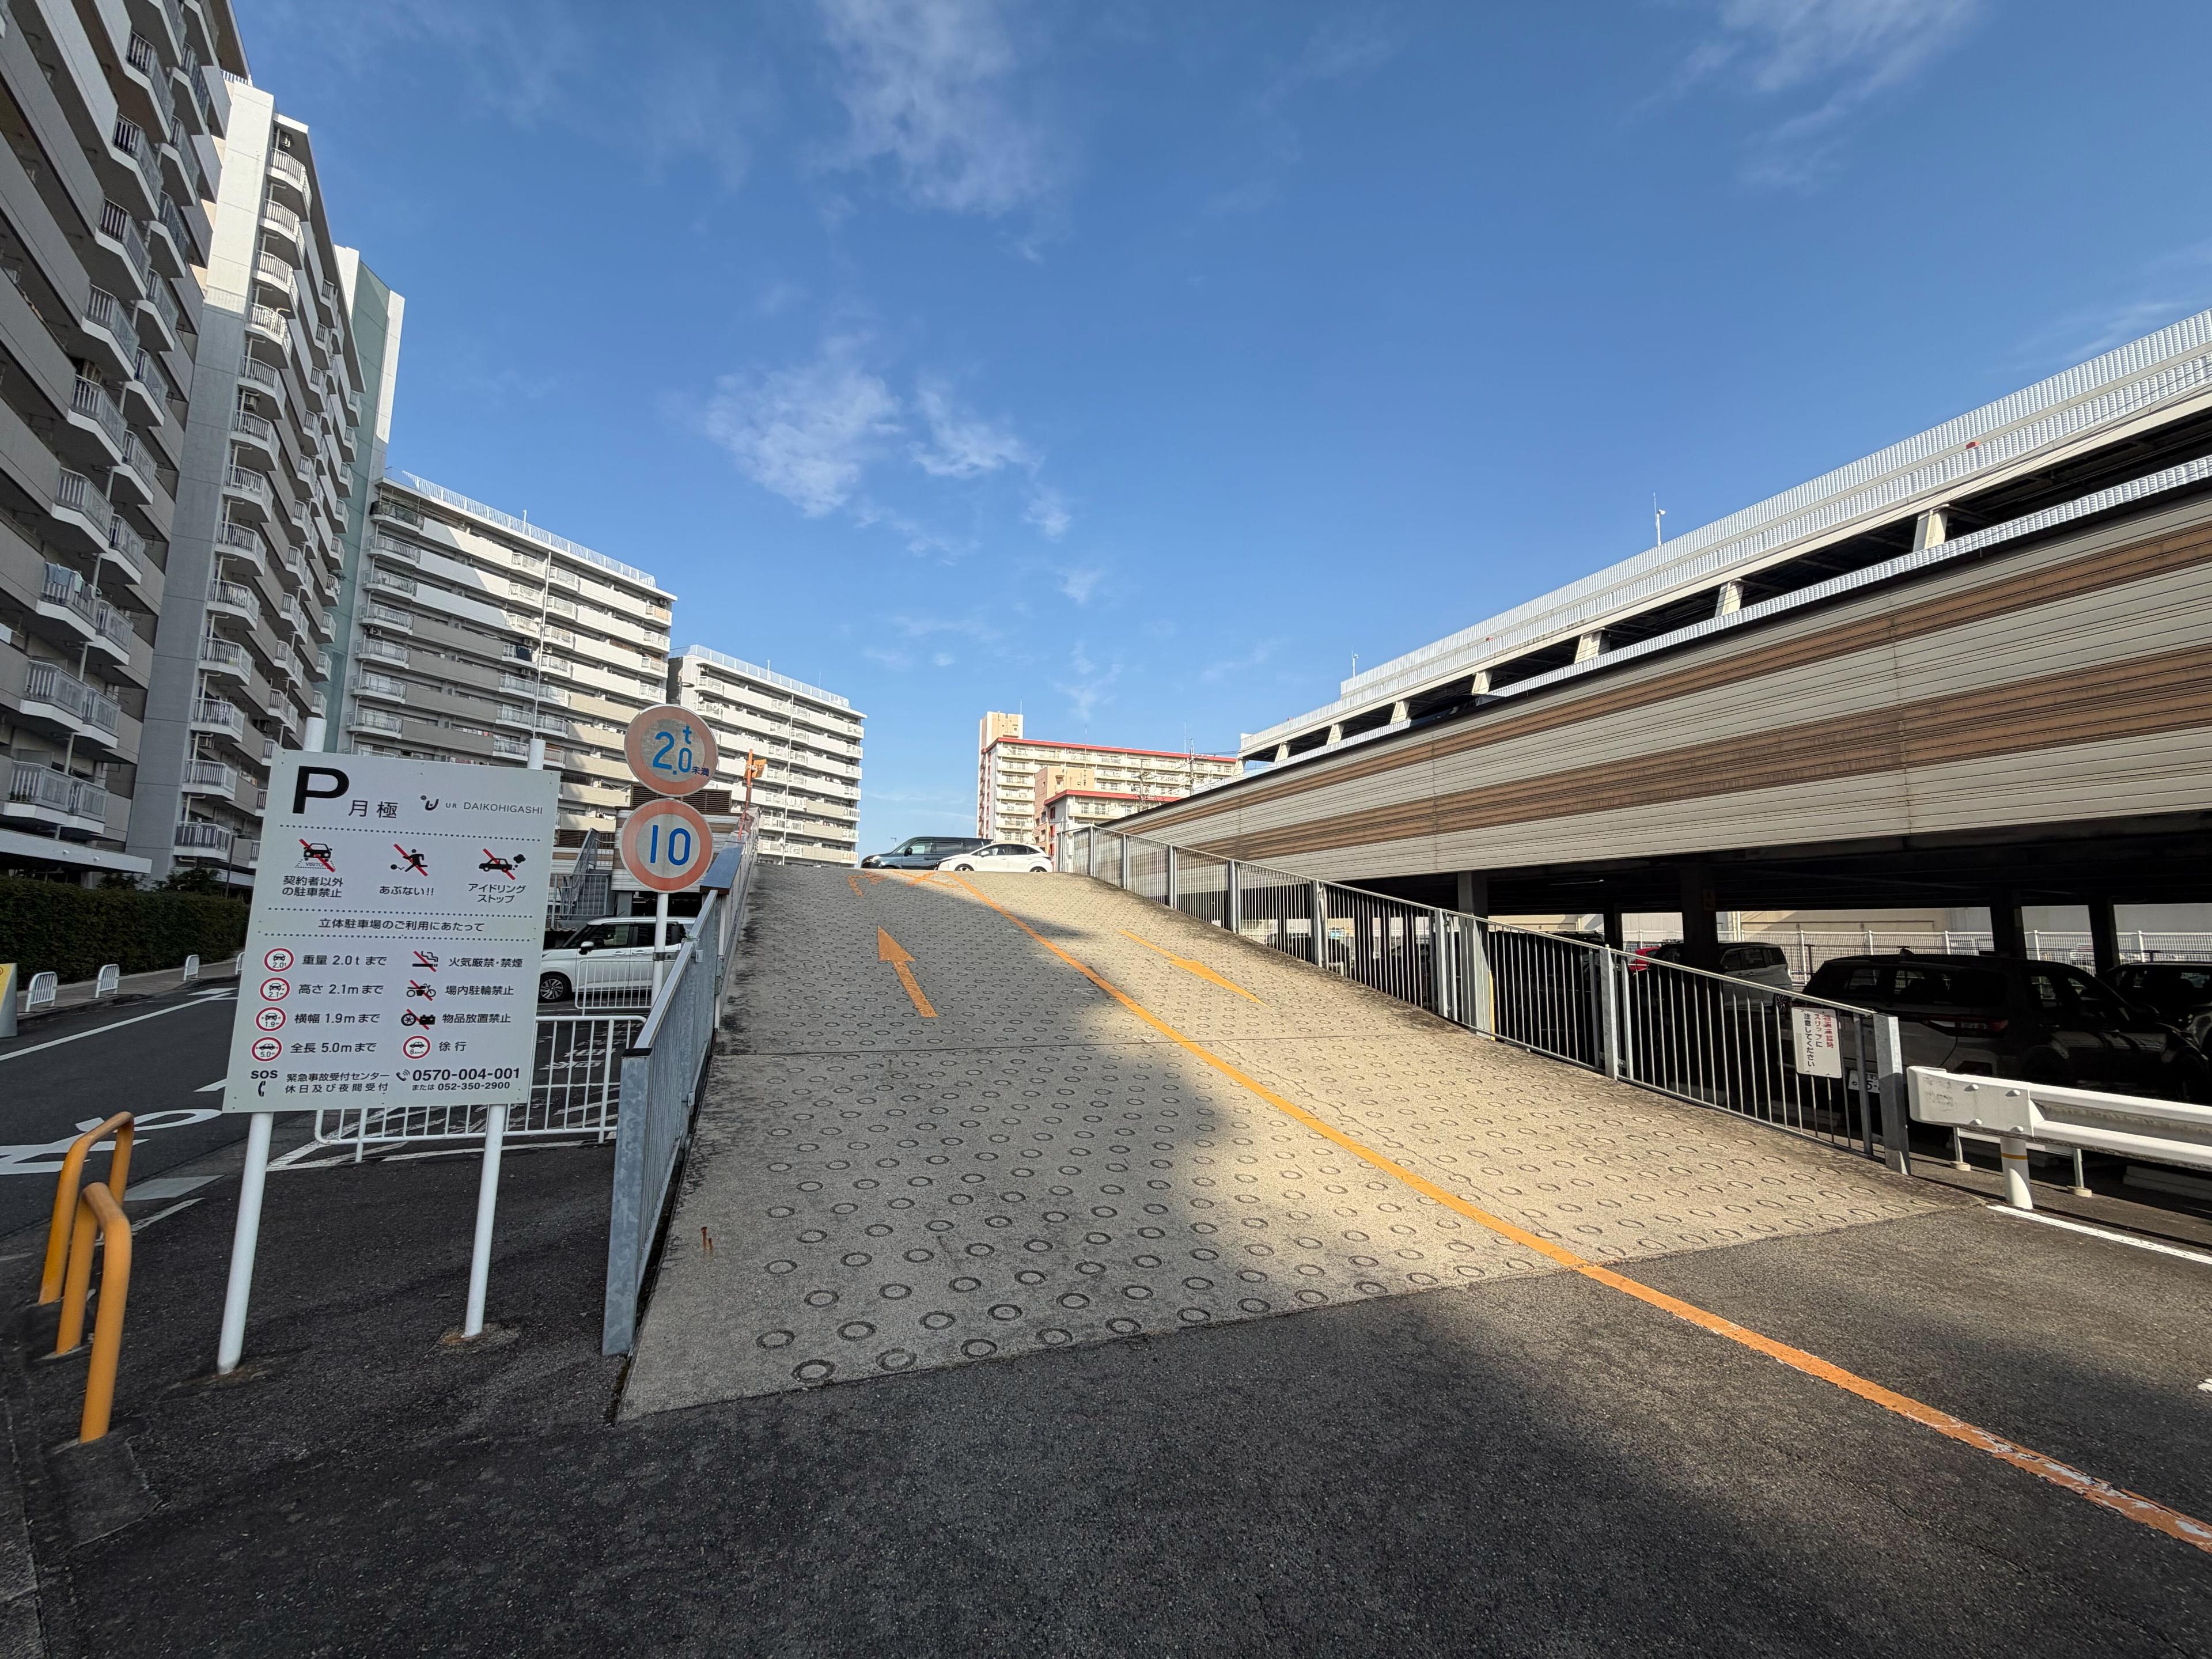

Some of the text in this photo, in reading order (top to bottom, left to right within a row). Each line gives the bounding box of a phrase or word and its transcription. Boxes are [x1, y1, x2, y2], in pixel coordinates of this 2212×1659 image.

[691, 765, 710, 777] 未満
[292, 766, 350, 815] P
[348, 800, 399, 819] 月極
[463, 802, 543, 815] DAIKOHIGASHI
[650, 825, 691, 866] 10
[282, 875, 344, 888] 契約者以外
[282, 887, 343, 899] の駐車禁止
[379, 885, 434, 896] あぶない!!
[468, 883, 527, 895] アイドリング
[477, 894, 516, 904] ストップ
[318, 918, 485, 932] 立体駐車場のご利用にあたって
[302, 955, 328, 965] 重量
[298, 984, 324, 994] 高さ
[445, 985, 514, 995] 場内駐輪禁止
[294, 1013, 321, 1024] 横幅
[442, 1013, 512, 1024] 物品放置禁止
[290, 1043, 316, 1054] 全長
[438, 1041, 467, 1052] 徐行
[251, 1070, 278, 1080] SOS
[286, 1072, 390, 1082] 緊急事故受付センター
[412, 1067, 520, 1081] 0570-004-001
[285, 1082, 389, 1094] 休日及び夜間受付
[438, 1081, 510, 1091] 052-350-2900
